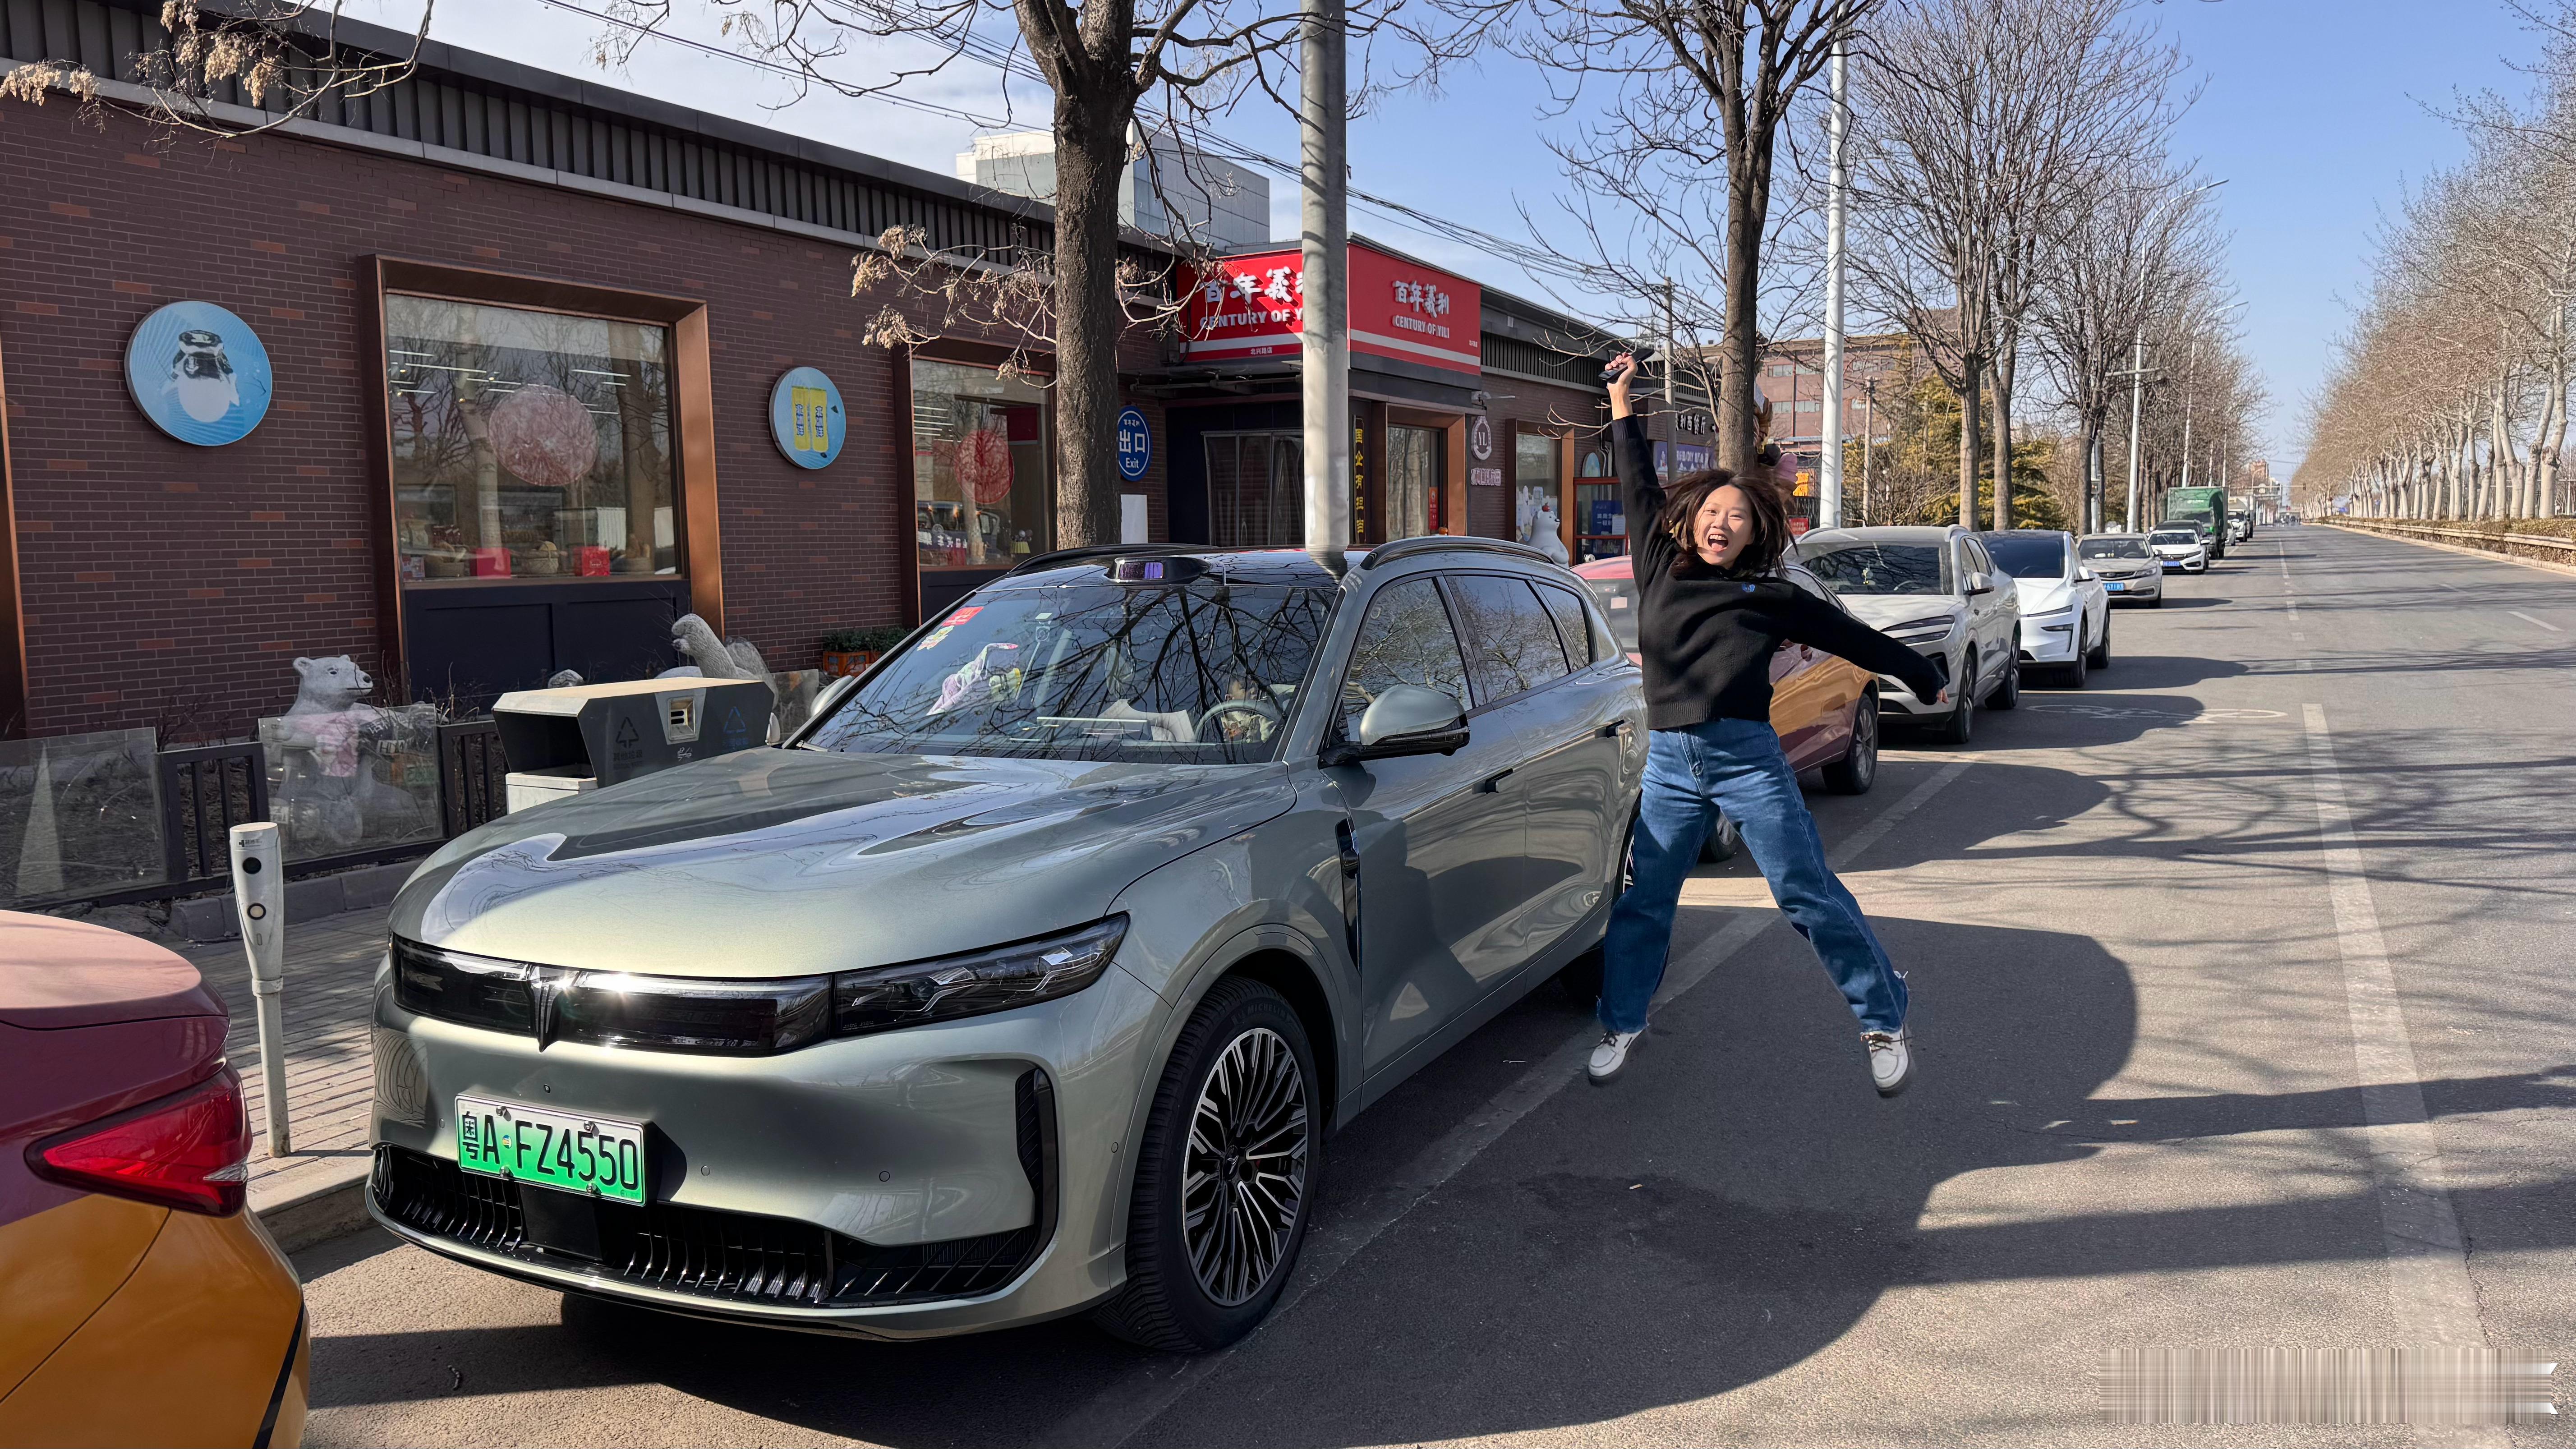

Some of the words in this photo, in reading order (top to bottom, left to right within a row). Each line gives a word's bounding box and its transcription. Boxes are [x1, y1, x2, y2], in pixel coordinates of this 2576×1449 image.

[1200, 311, 1267, 329] CENTURY
[1271, 309, 1291, 322] OF
[1394, 315, 1426, 332] CENTURY
[1428, 322, 1436, 335] OF
[1437, 325, 1449, 339] YILI
[1119, 429, 1145, 454] 出口
[1126, 457, 1139, 469] Exit
[1247, 1003, 1286, 1018] MICHELIN
